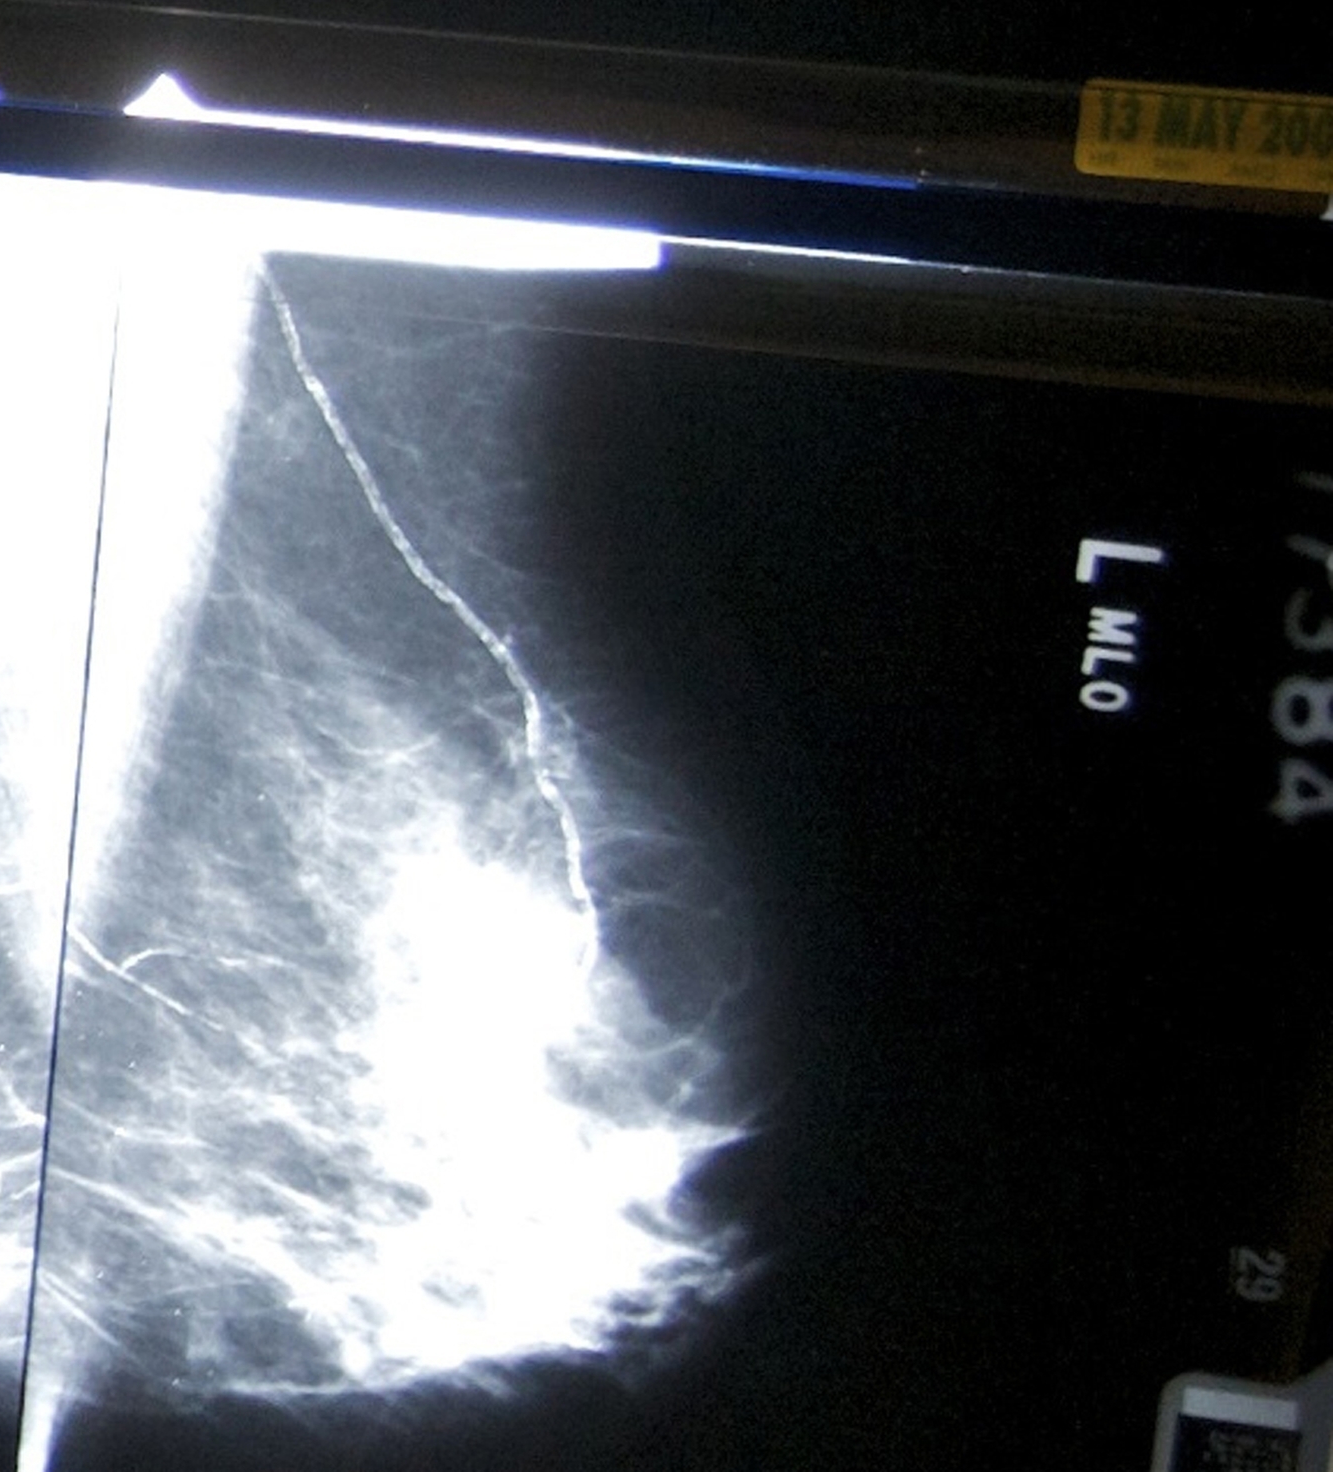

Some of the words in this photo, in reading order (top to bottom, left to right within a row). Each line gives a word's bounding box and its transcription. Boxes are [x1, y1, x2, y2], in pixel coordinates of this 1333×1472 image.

[1099, 90, 1140, 144] 13
[1155, 94, 1247, 152] MAY
[1075, 537, 1164, 584] L
[1078, 606, 1139, 714] MLO
